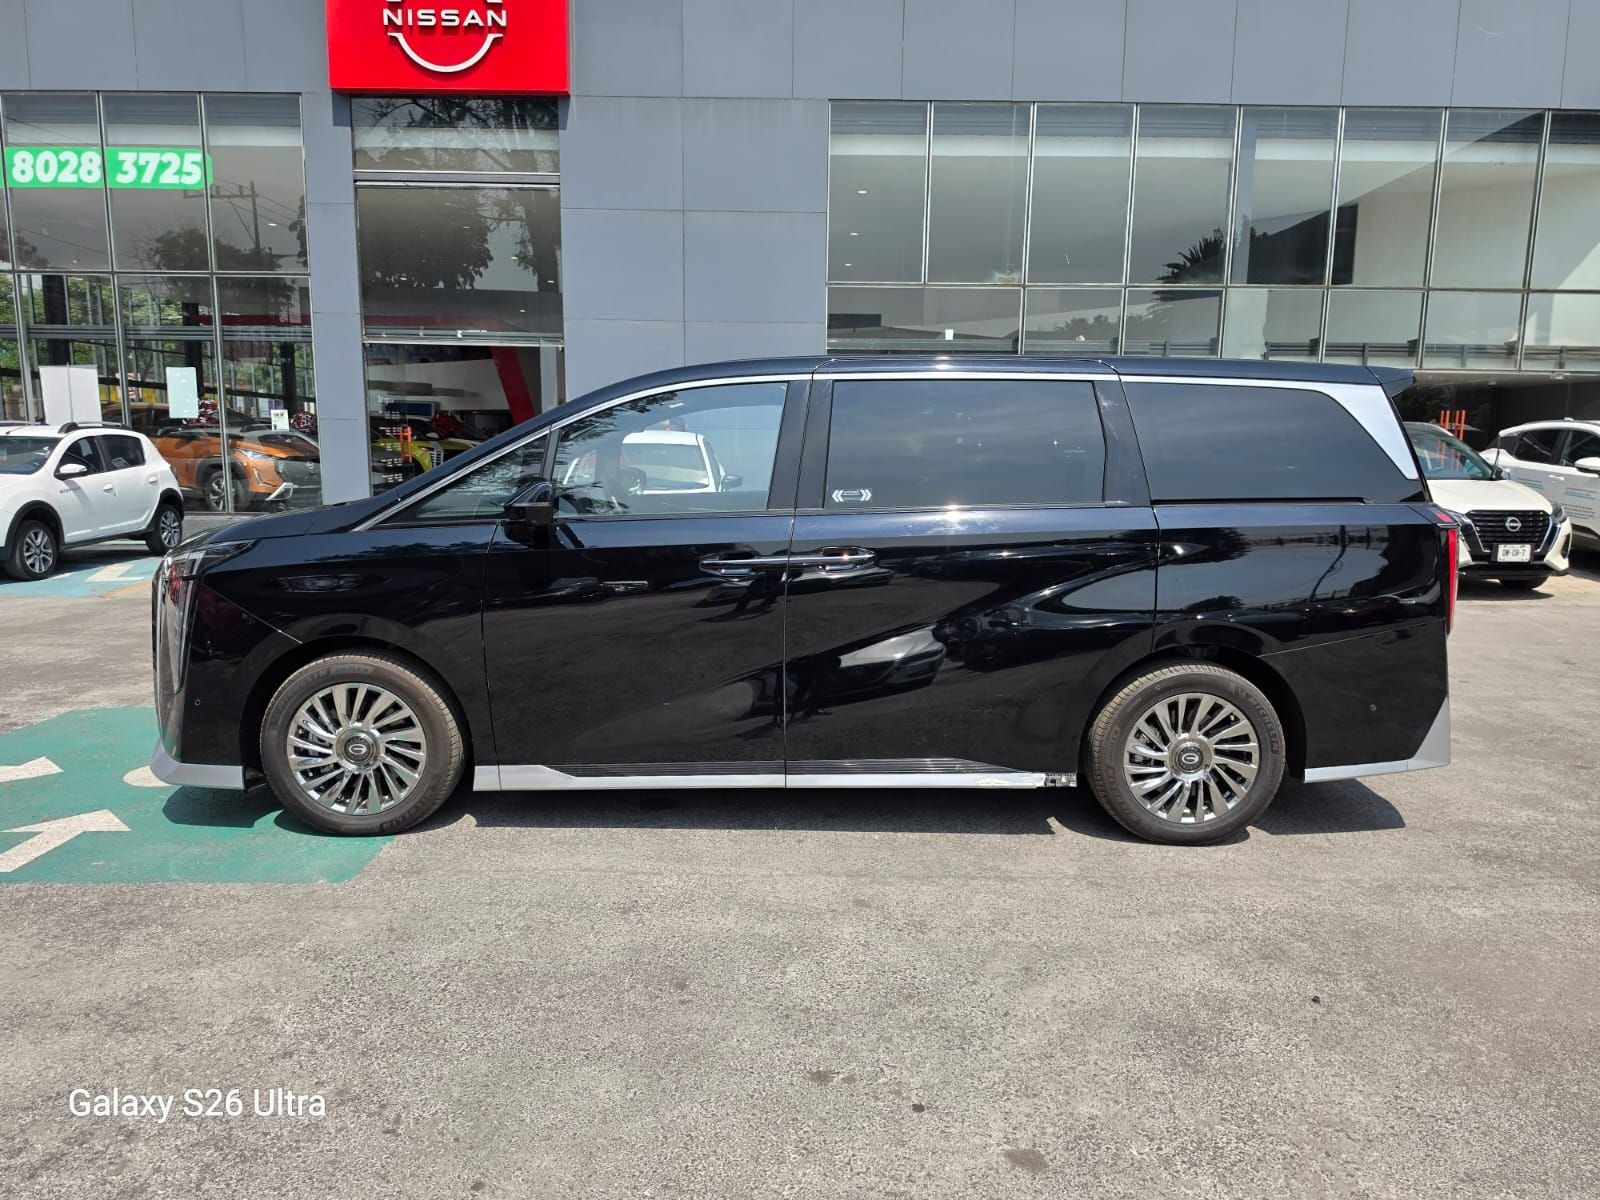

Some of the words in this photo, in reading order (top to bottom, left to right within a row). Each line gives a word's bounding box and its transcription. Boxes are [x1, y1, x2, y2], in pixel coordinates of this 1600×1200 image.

[383, 9, 507, 27] NISSAN
[12, 150, 101, 183] 8028
[115, 152, 202, 185] 3725
